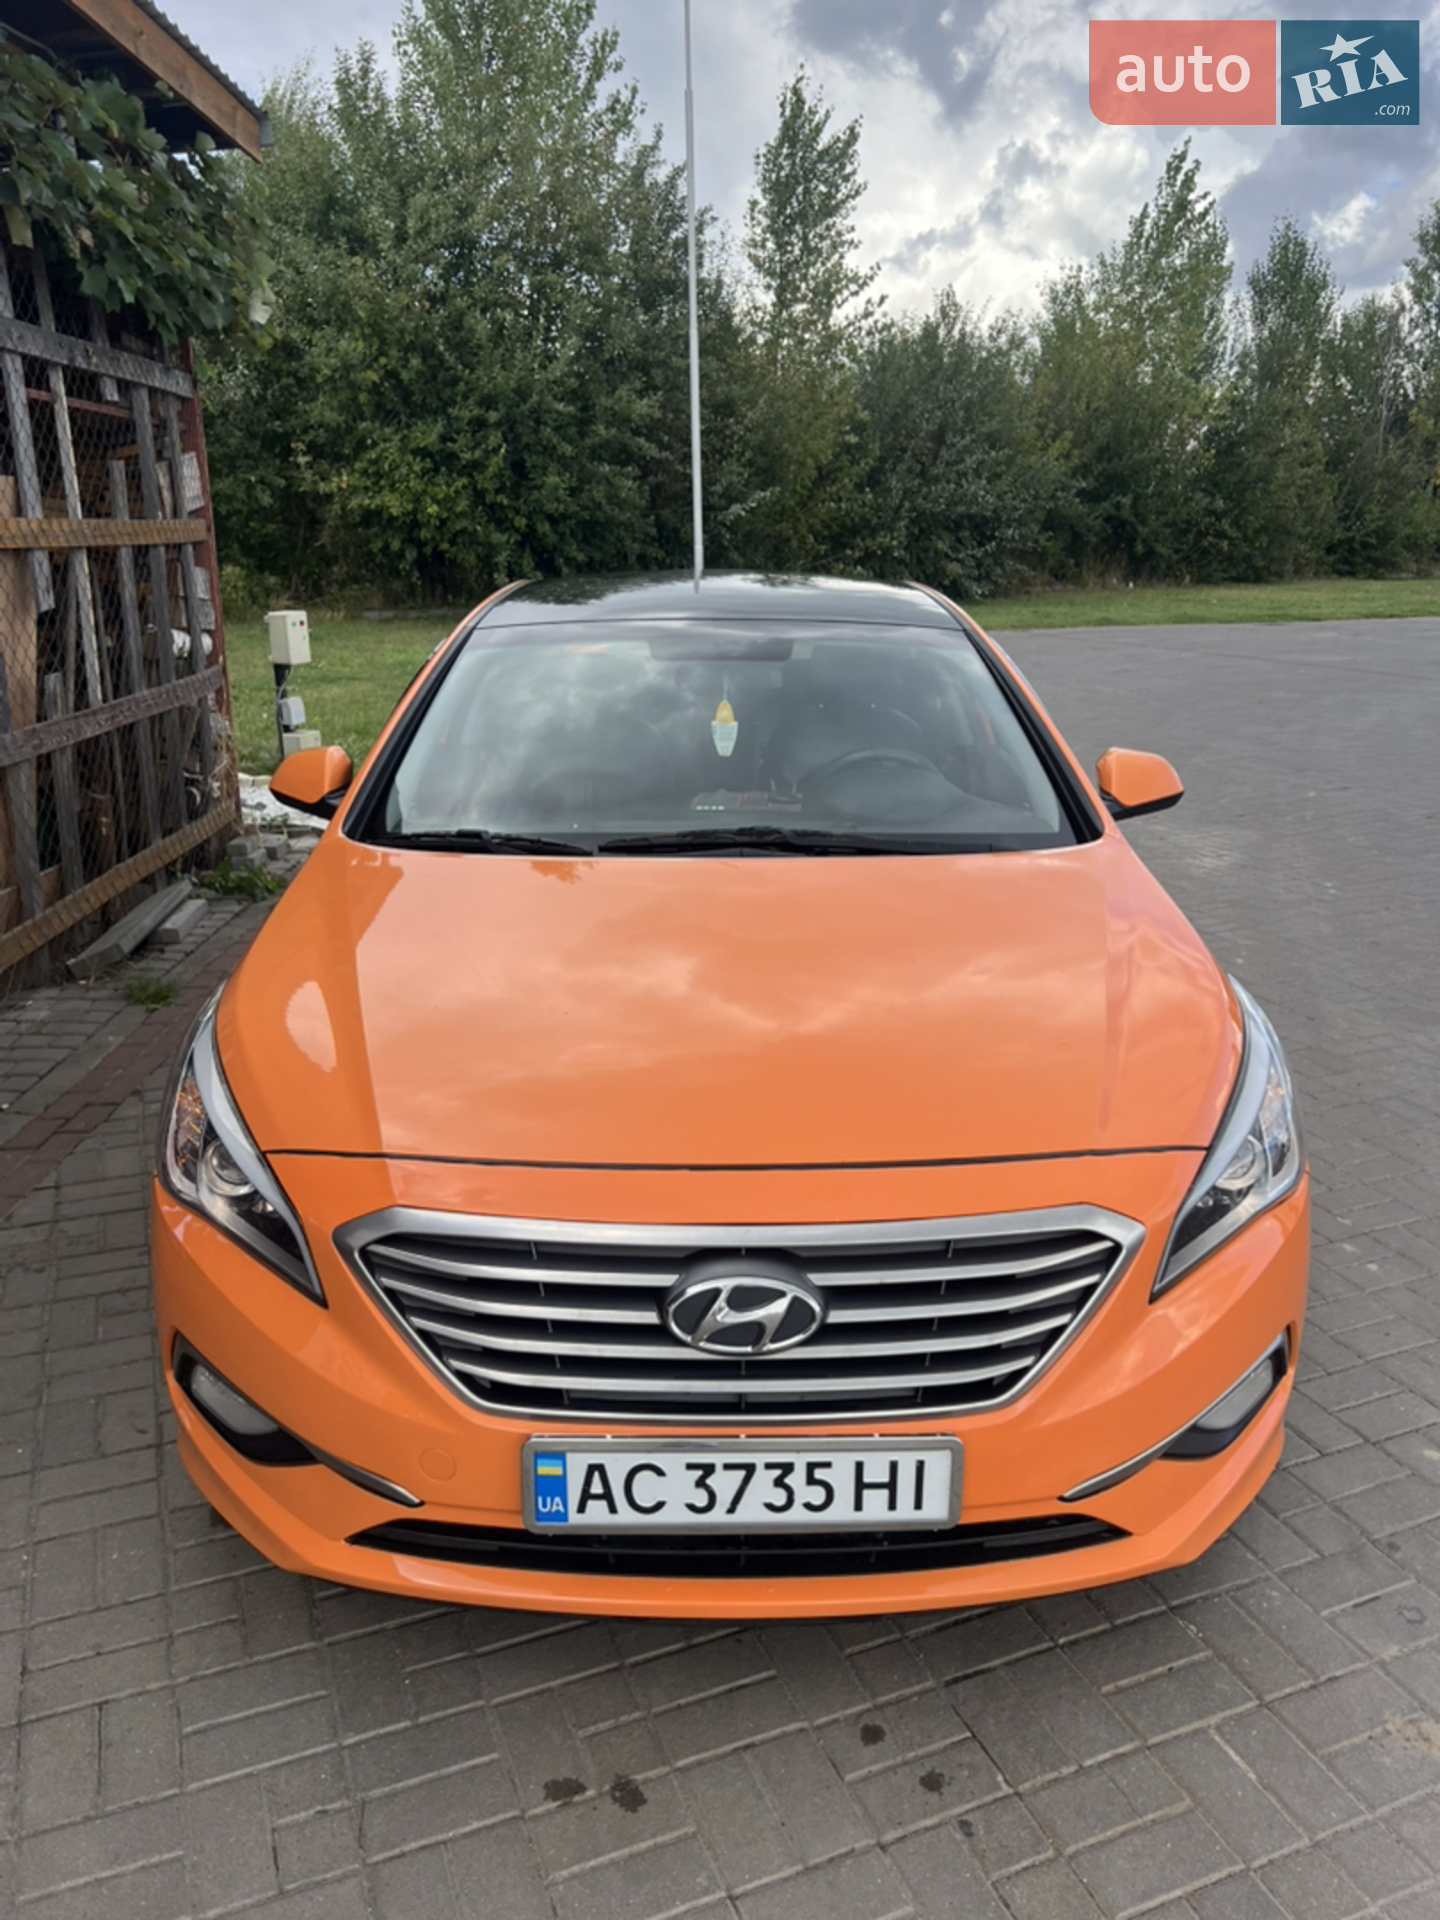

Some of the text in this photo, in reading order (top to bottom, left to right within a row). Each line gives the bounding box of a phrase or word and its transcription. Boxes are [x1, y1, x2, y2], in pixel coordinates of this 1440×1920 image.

[537, 1496, 564, 1514] UA
[575, 1459, 926, 1515] AC 3735 HI
